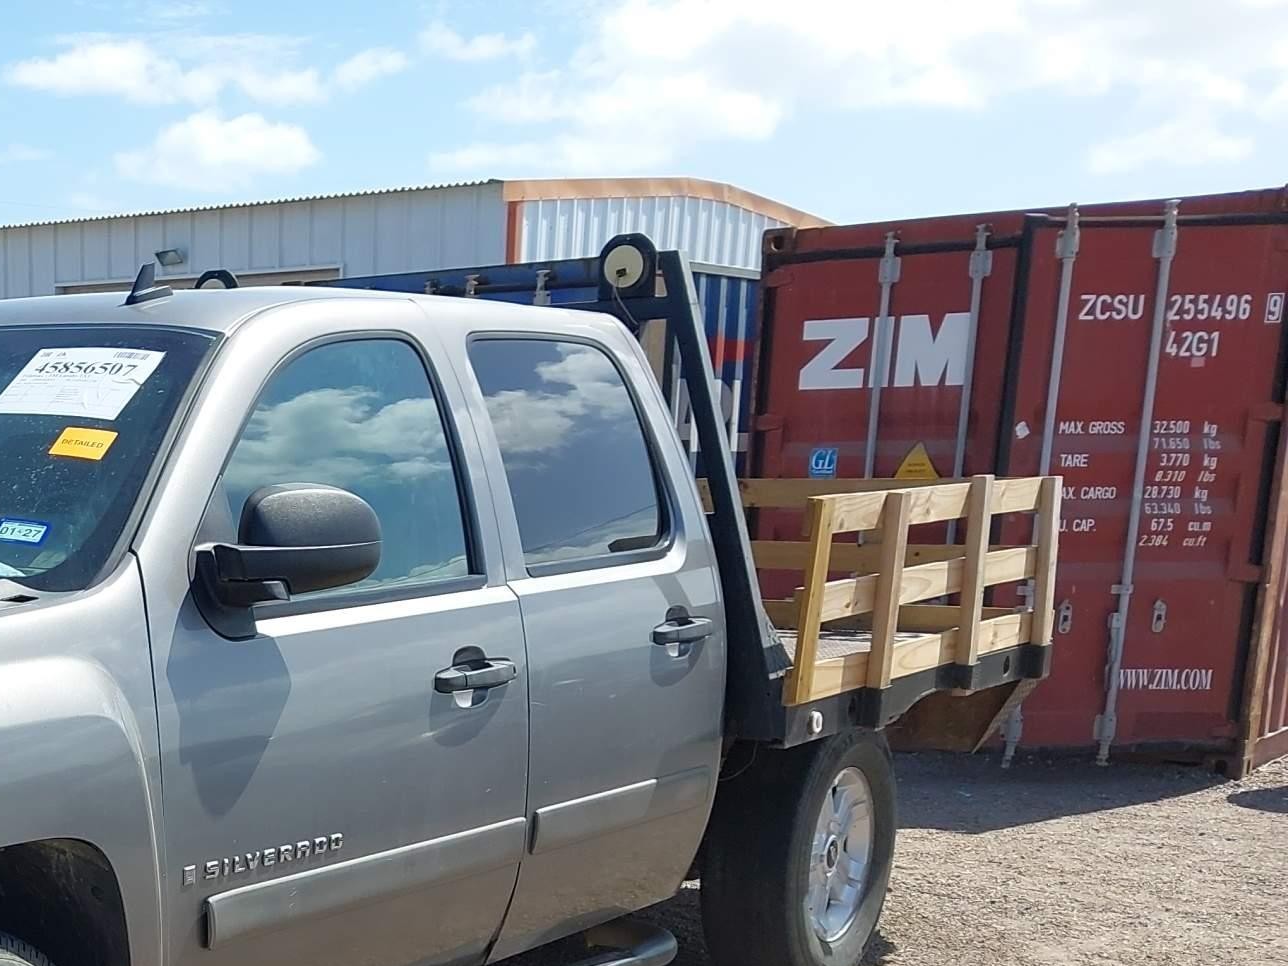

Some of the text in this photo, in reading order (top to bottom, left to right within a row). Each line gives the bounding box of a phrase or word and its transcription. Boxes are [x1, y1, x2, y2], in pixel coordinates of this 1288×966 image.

[1078, 294, 1145, 321] ZCSU
[1168, 294, 1253, 321] 255496
[798, 312, 972, 391] ZIM
[1165, 331, 1221, 357] 42G1
[35, 361, 139, 377] 45856507
[1088, 421, 1126, 435] GROSS
[1153, 420, 1190, 434] 32.500
[1202, 420, 1218, 437] kg
[61, 439, 104, 449] DETAILED
[812, 449, 835, 470] GL
[1059, 453, 1218, 470] TARE 3.770 kg
[1196, 470, 1217, 482] lbs
[1080, 486, 1117, 499] CARGO
[1143, 485, 1182, 499] 28.730
[1194, 485, 1209, 502] kg
[1144, 503, 1181, 514] 63.340
[1072, 519, 1097, 532] CAP.
[1150, 519, 1174, 532] 67.5
[204, 832, 344, 880] SILVERADO
